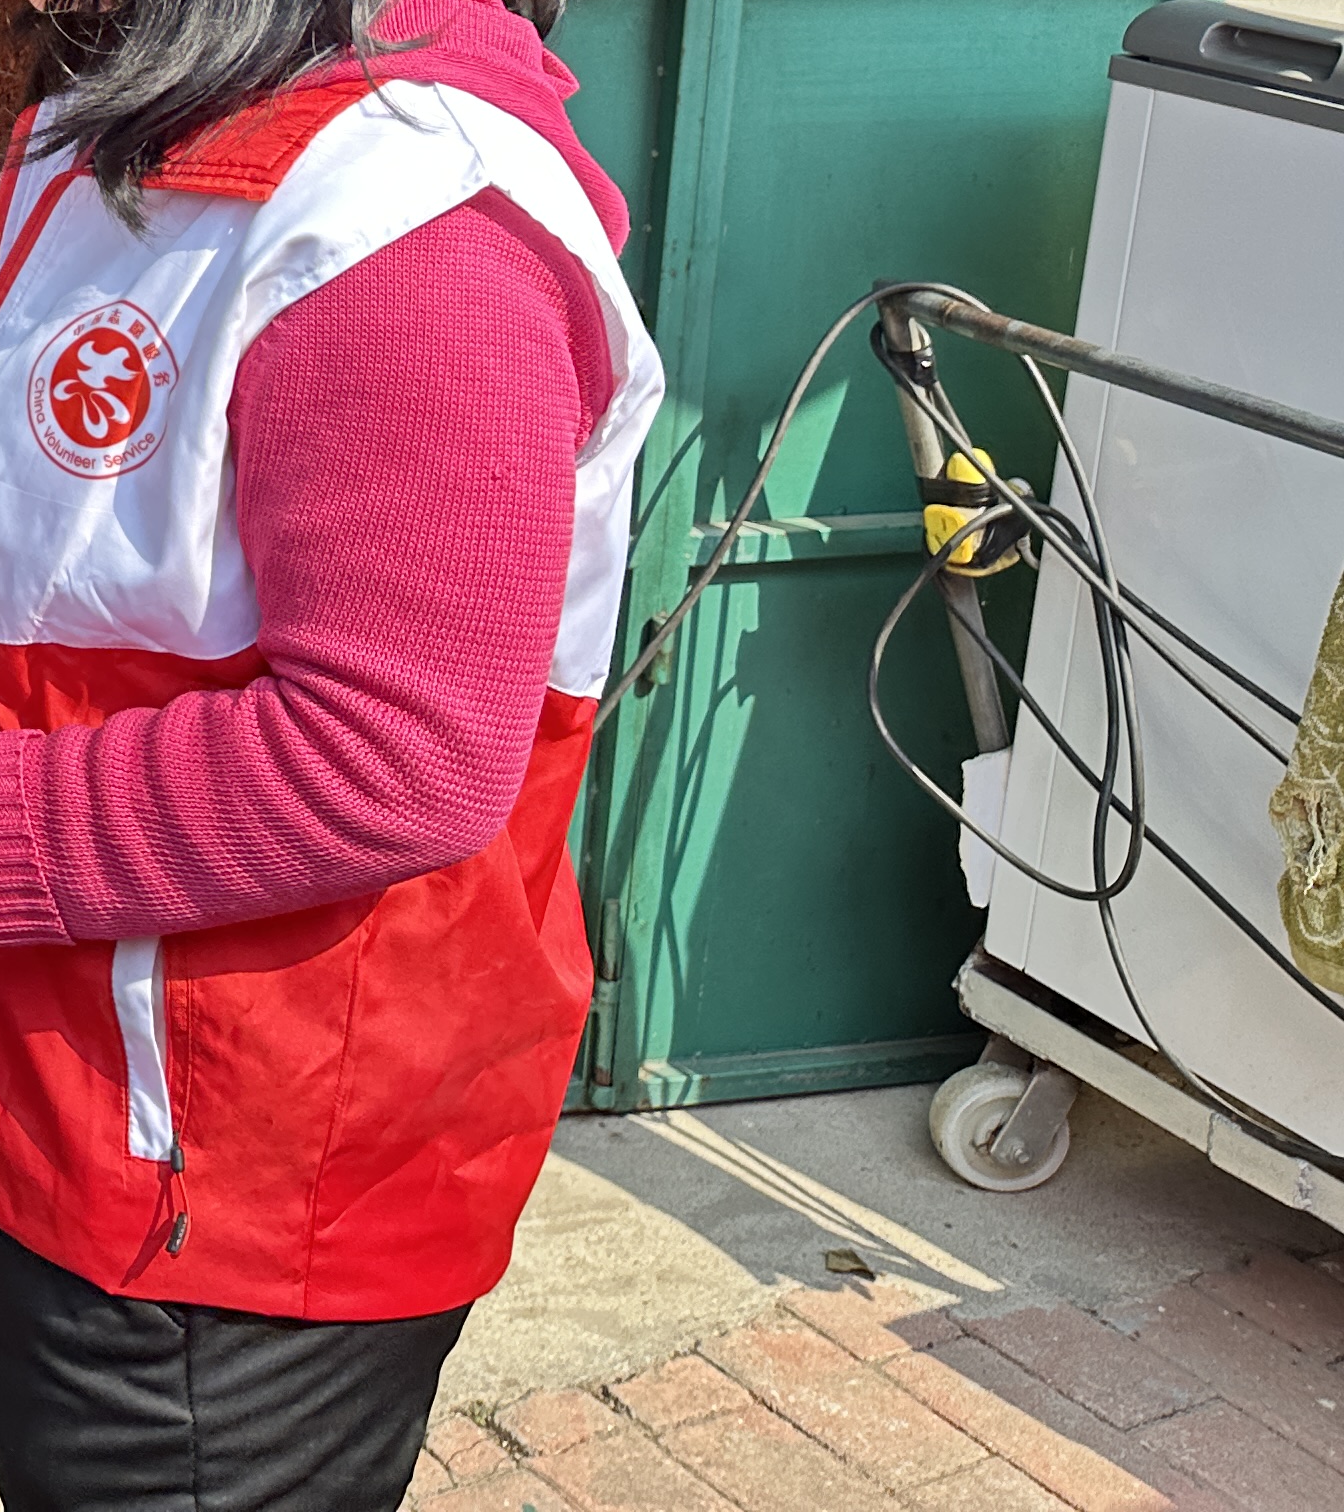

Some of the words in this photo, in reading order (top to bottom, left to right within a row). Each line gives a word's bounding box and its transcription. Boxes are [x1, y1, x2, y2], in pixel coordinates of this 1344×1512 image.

[34, 377, 46, 424] China
[44, 425, 97, 470] Volunteer
[103, 432, 156, 469] Service
